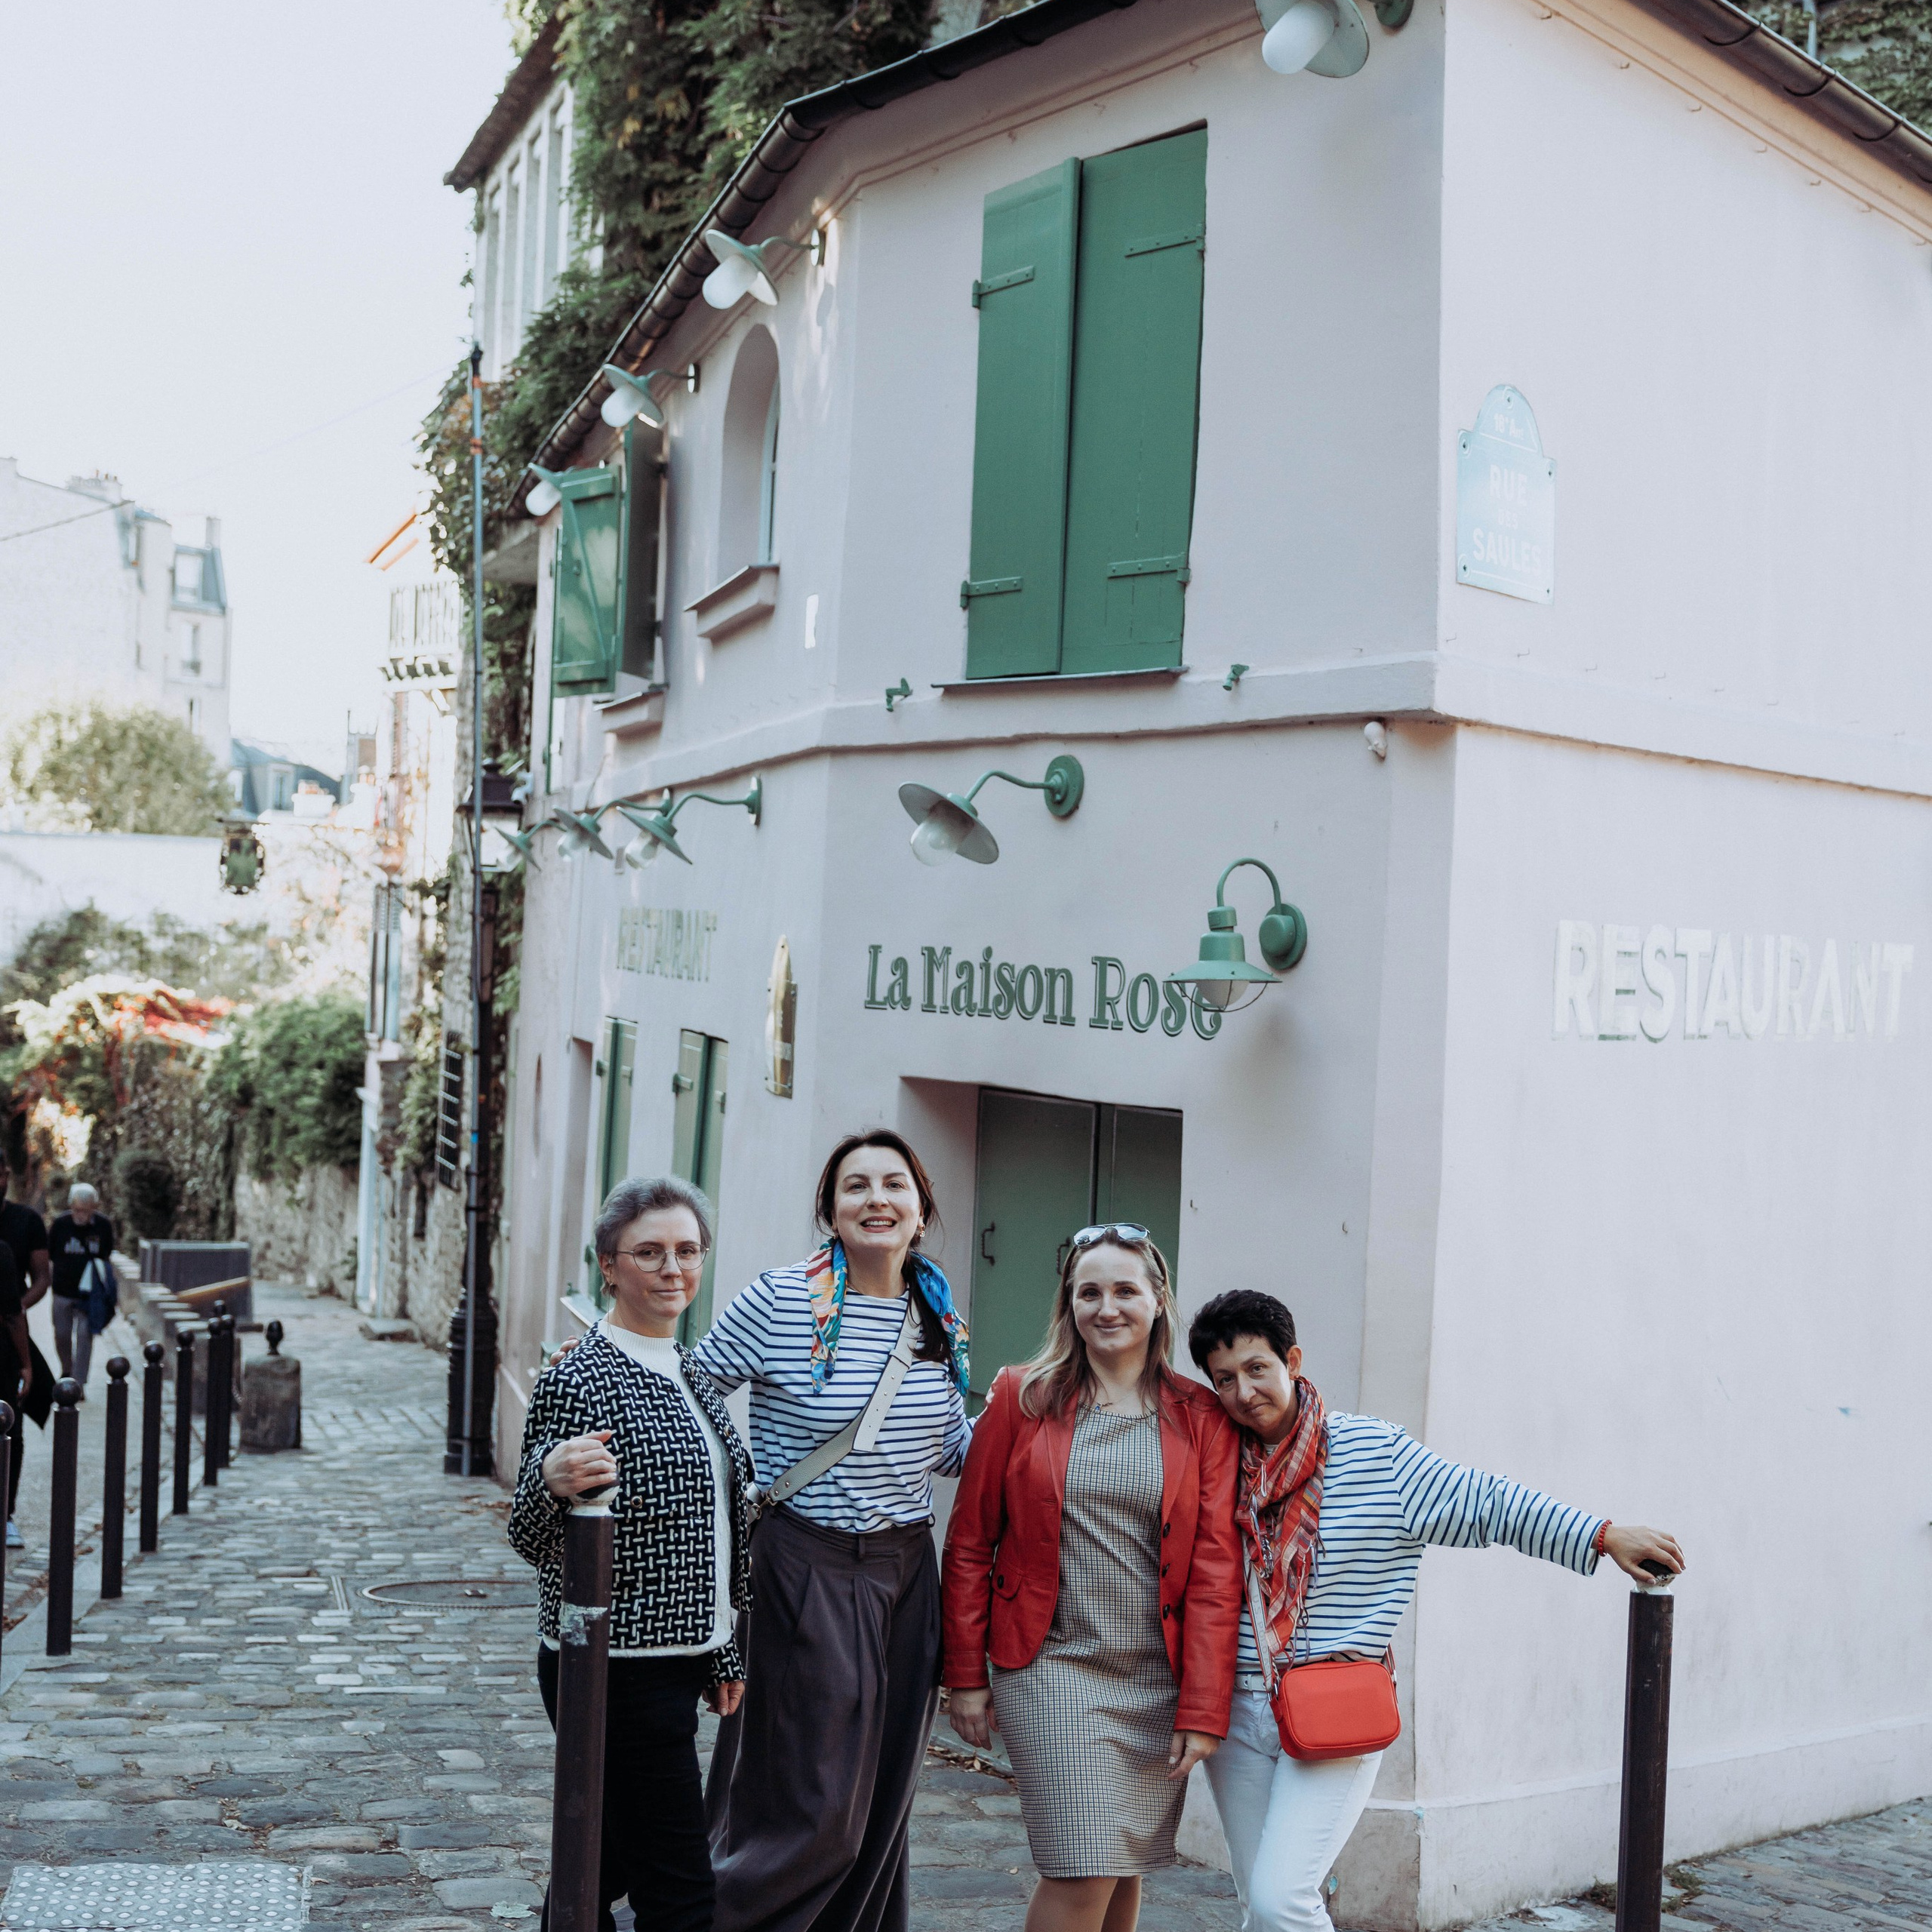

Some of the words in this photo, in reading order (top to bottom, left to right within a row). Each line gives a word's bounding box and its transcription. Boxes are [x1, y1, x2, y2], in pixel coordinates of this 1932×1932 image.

[1490, 464, 1528, 507] RUE
[1472, 528, 1543, 577] SAULES
[864, 943, 912, 1011] La
[920, 946, 1077, 1025] Maison
[1551, 919, 1915, 1044] RESTAURANT
